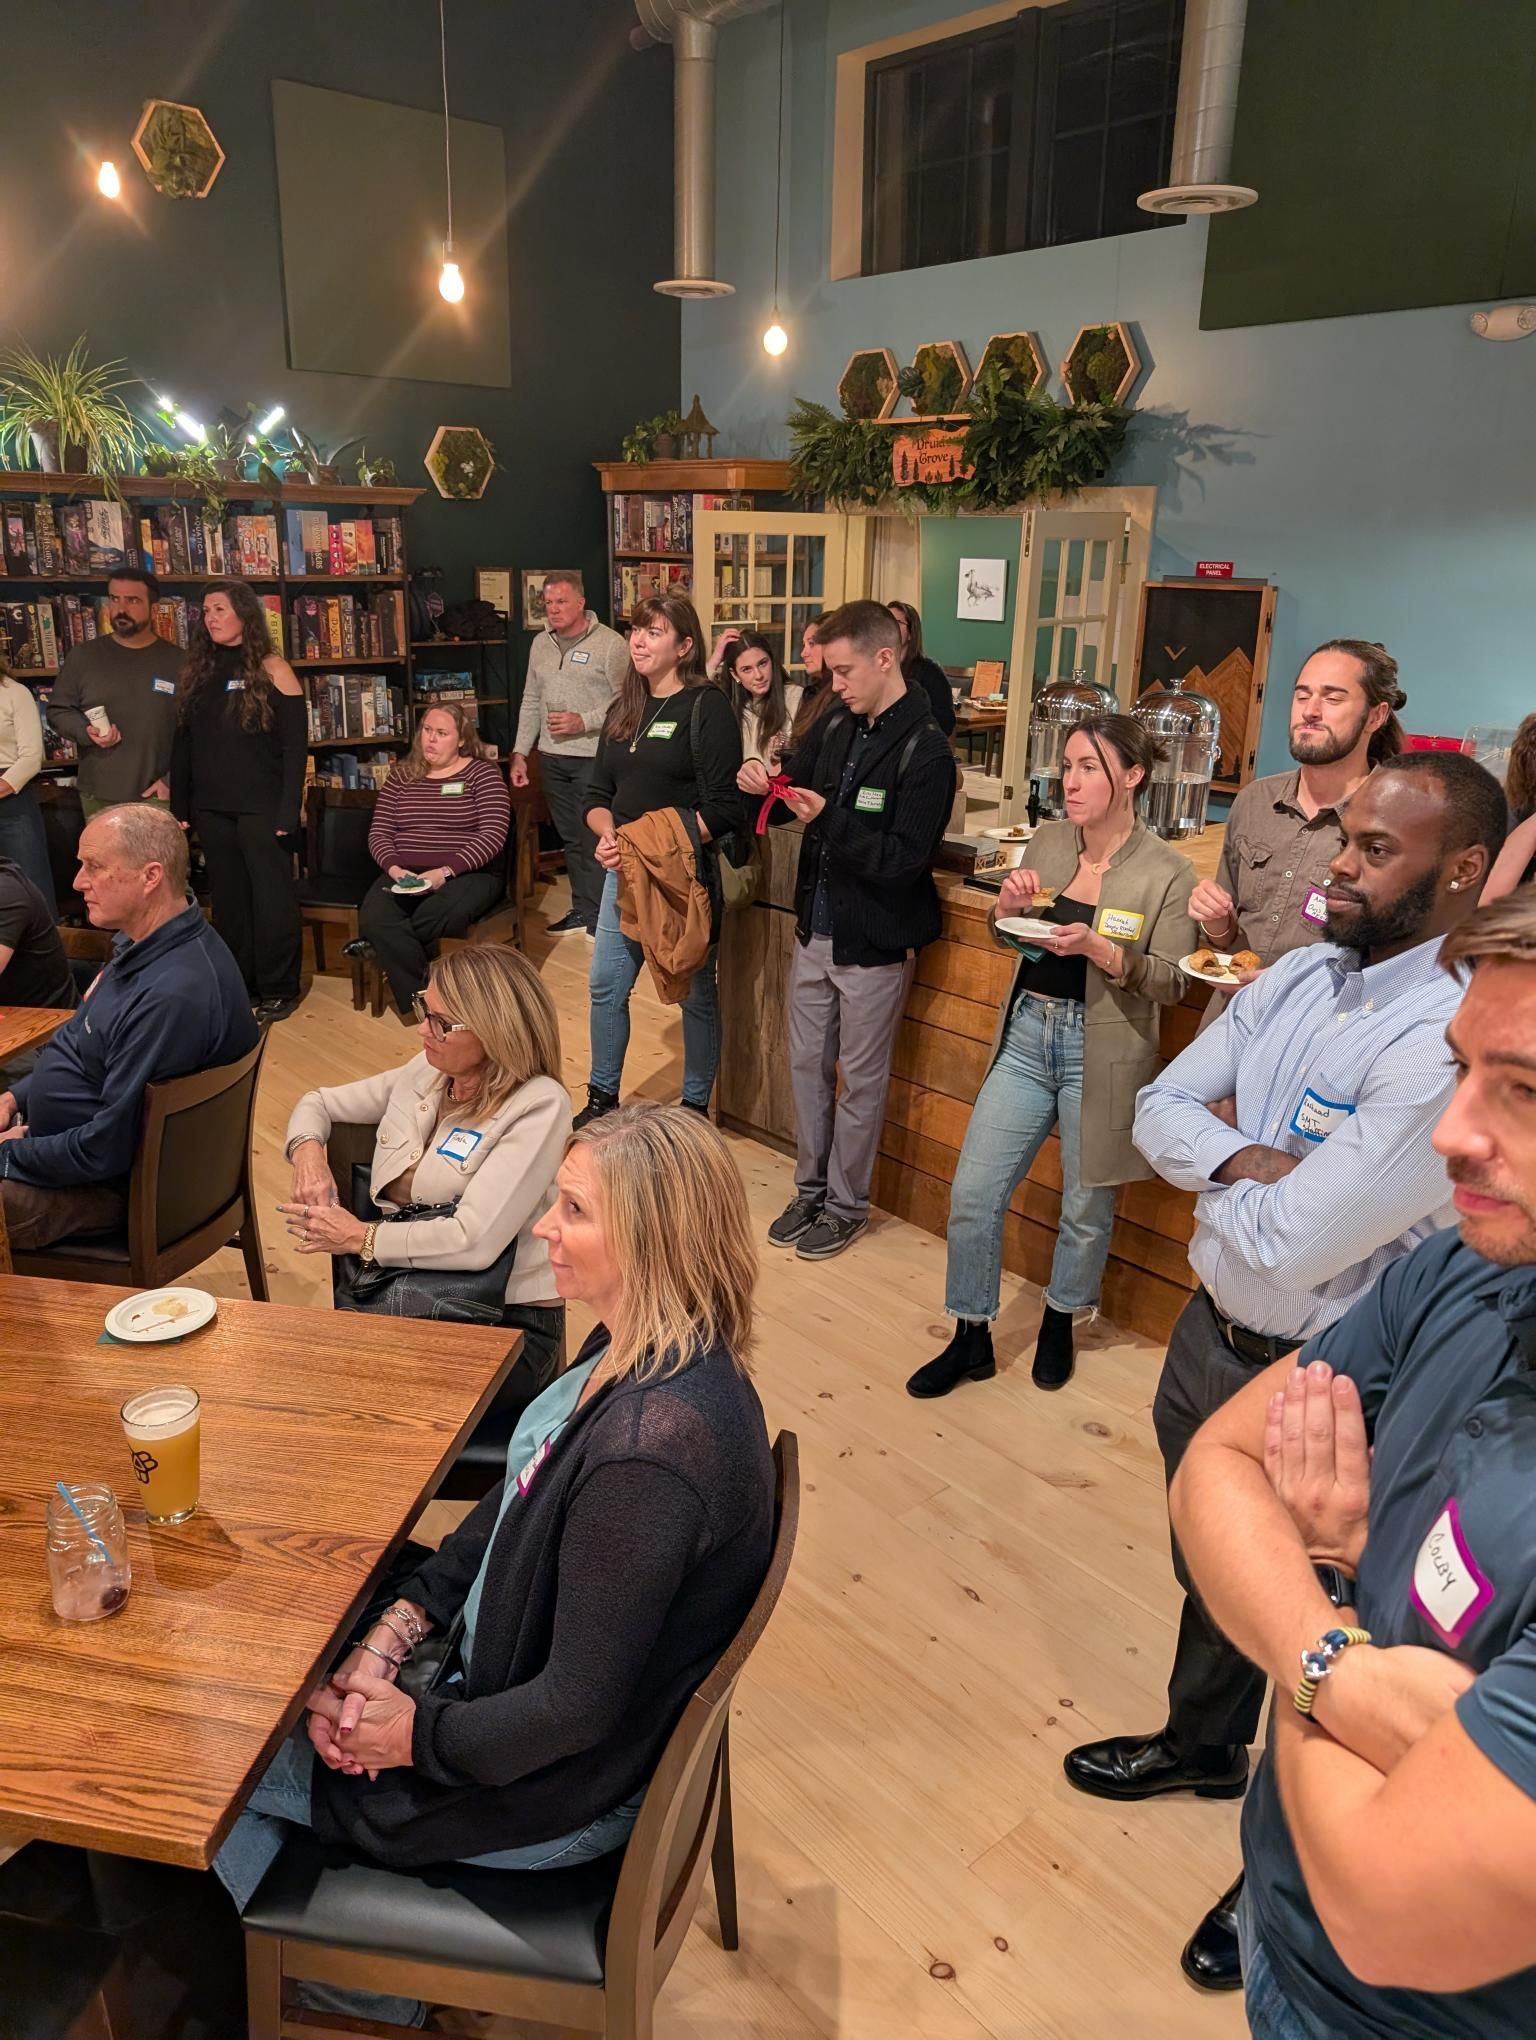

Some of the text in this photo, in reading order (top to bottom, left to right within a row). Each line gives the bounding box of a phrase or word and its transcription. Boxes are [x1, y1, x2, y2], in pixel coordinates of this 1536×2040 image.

[918, 452, 949, 464] Grove
[195, 515, 204, 555] AQUATICA
[1302, 1124, 1333, 1137] Staffin
[1428, 1533, 1457, 1592] COLBY
